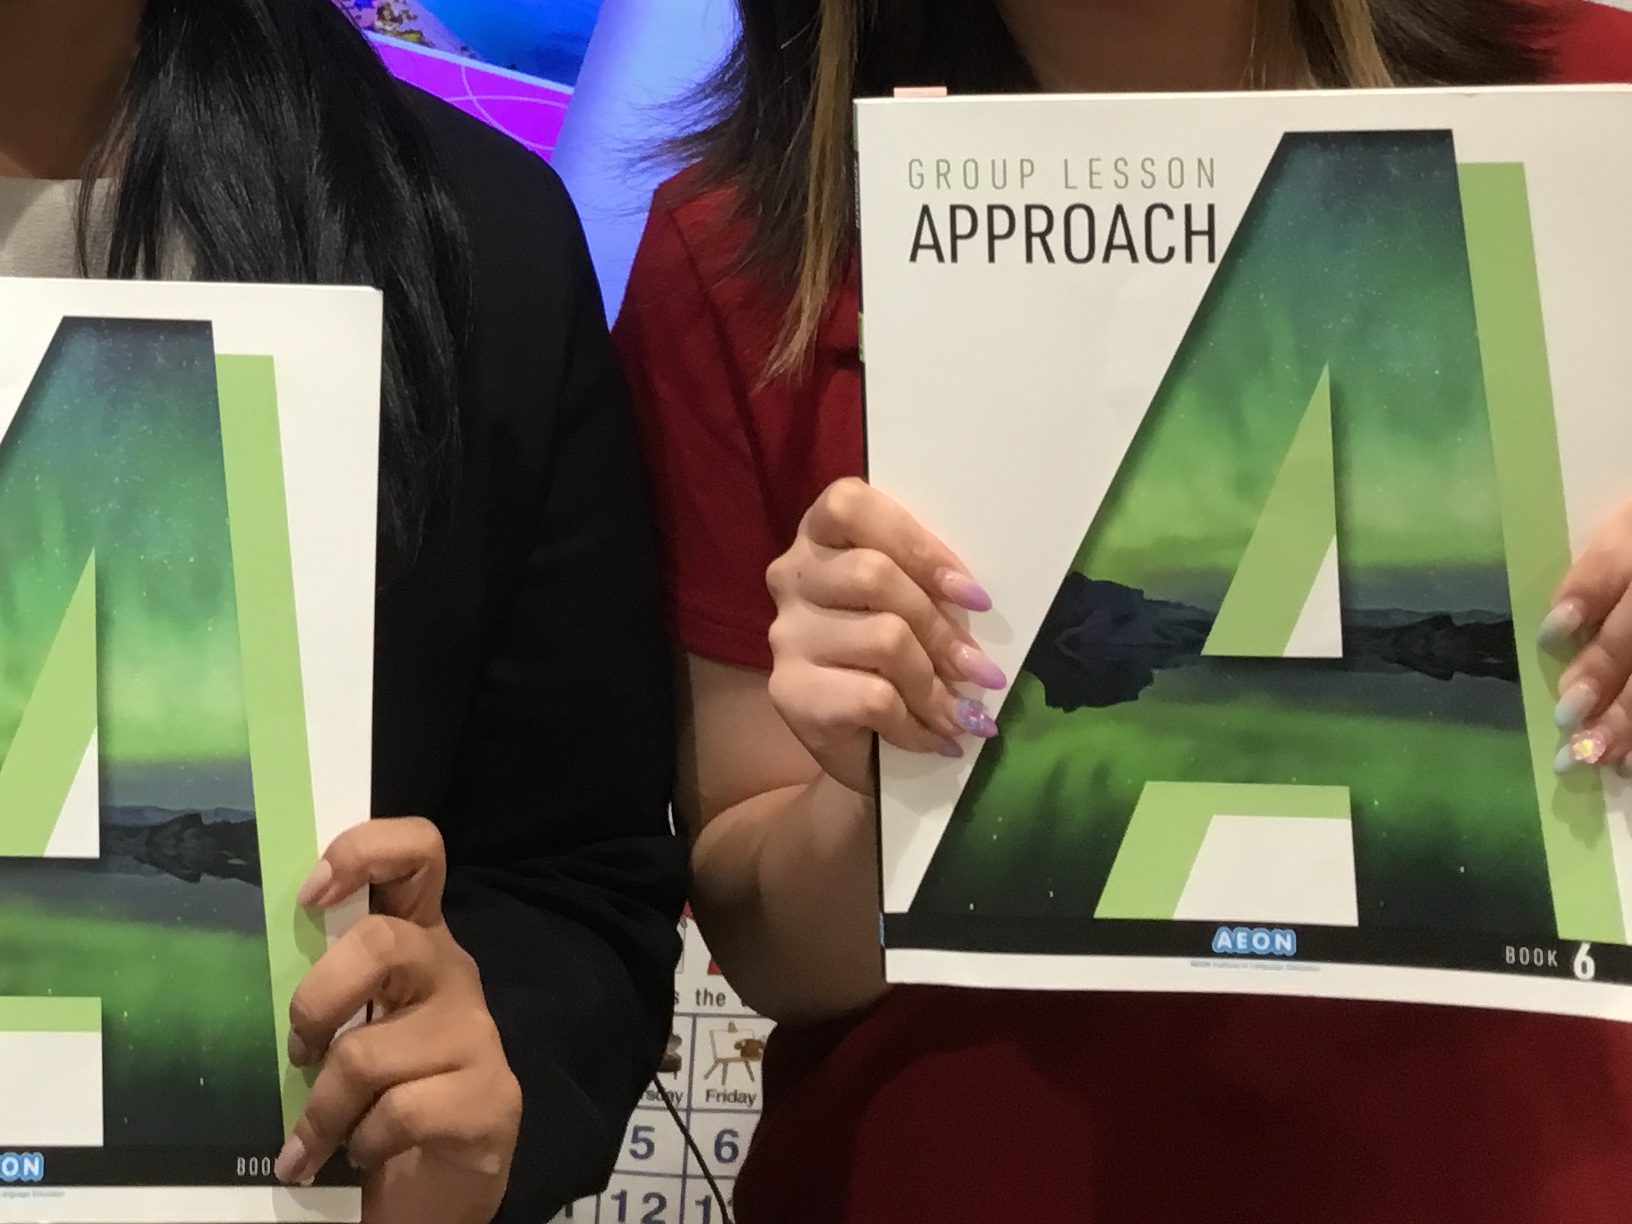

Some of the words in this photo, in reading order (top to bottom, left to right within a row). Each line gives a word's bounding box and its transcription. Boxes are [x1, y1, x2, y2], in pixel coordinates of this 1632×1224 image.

[908, 157, 1035, 190] GROUP
[1063, 156, 1215, 190] LESSON
[909, 202, 1216, 264] APPROACH
[1214, 928, 1295, 954] AEON
[1505, 945, 1558, 967] BOOK
[1573, 941, 1596, 980] 6
[695, 988, 727, 1007] the
[705, 1088, 757, 1108] Friday
[629, 1125, 656, 1160] 5
[714, 1128, 739, 1164] 6
[237, 1156, 276, 1176] BOO
[611, 1189, 668, 1224] 12
